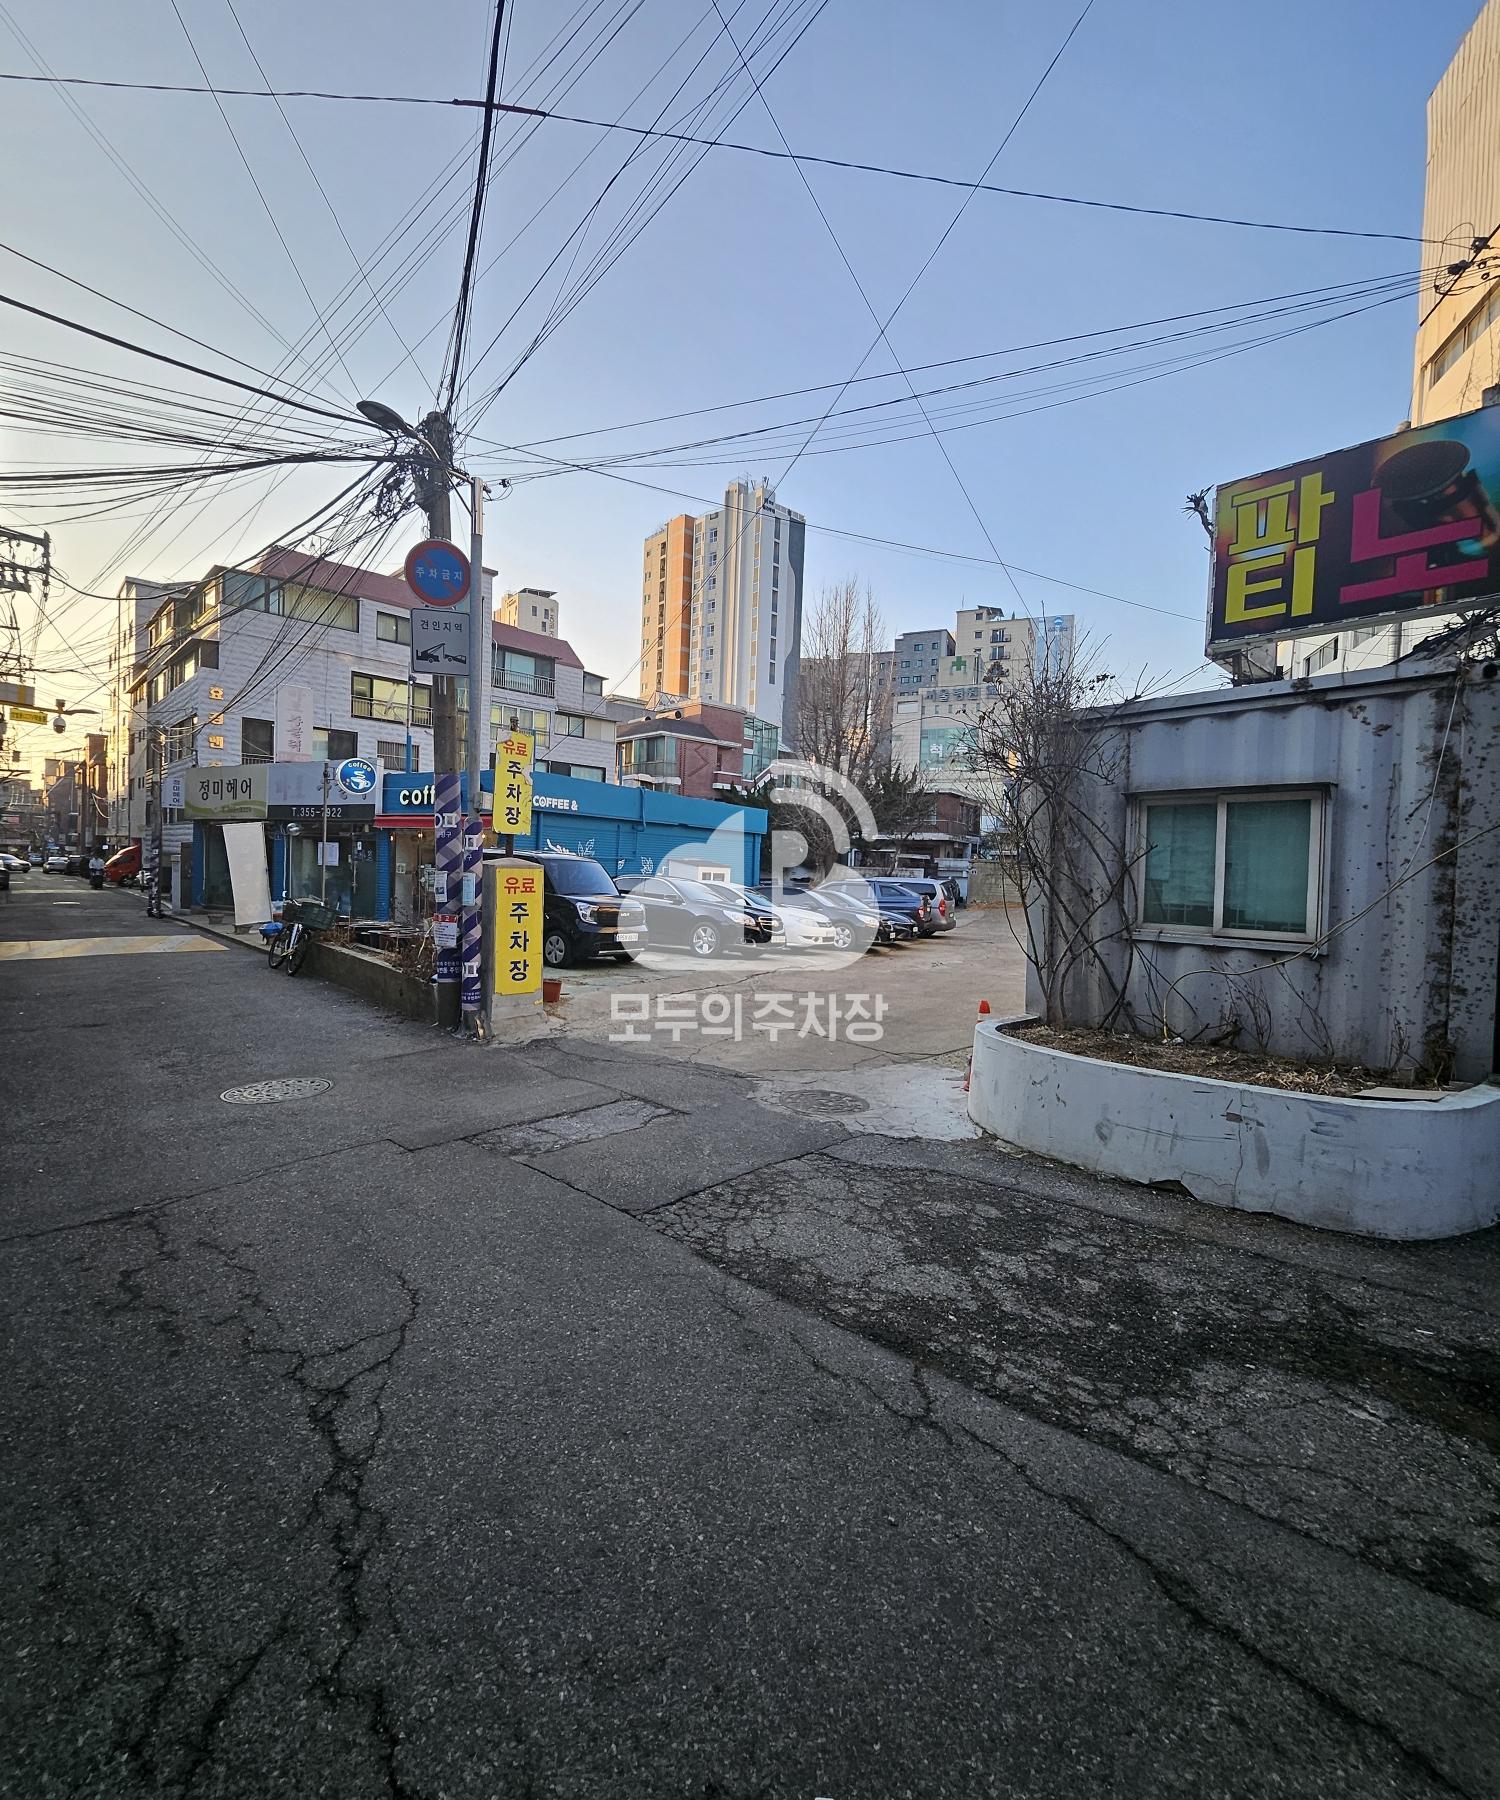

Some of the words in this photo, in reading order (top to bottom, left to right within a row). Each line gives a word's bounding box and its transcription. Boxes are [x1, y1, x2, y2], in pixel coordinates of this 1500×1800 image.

[1225, 472, 1335, 623] 파티
[416, 566, 463, 581] 주차금지
[420, 619, 463, 632] 견인지역
[503, 740, 528, 757] 유료
[348, 761, 372, 772] coffee
[199, 778, 252, 801] 정미헤어
[505, 760, 522, 825] 주차장
[533, 795, 570, 810] COFFEE
[504, 876, 536, 895] 유료
[508, 902, 530, 982] 주차장
